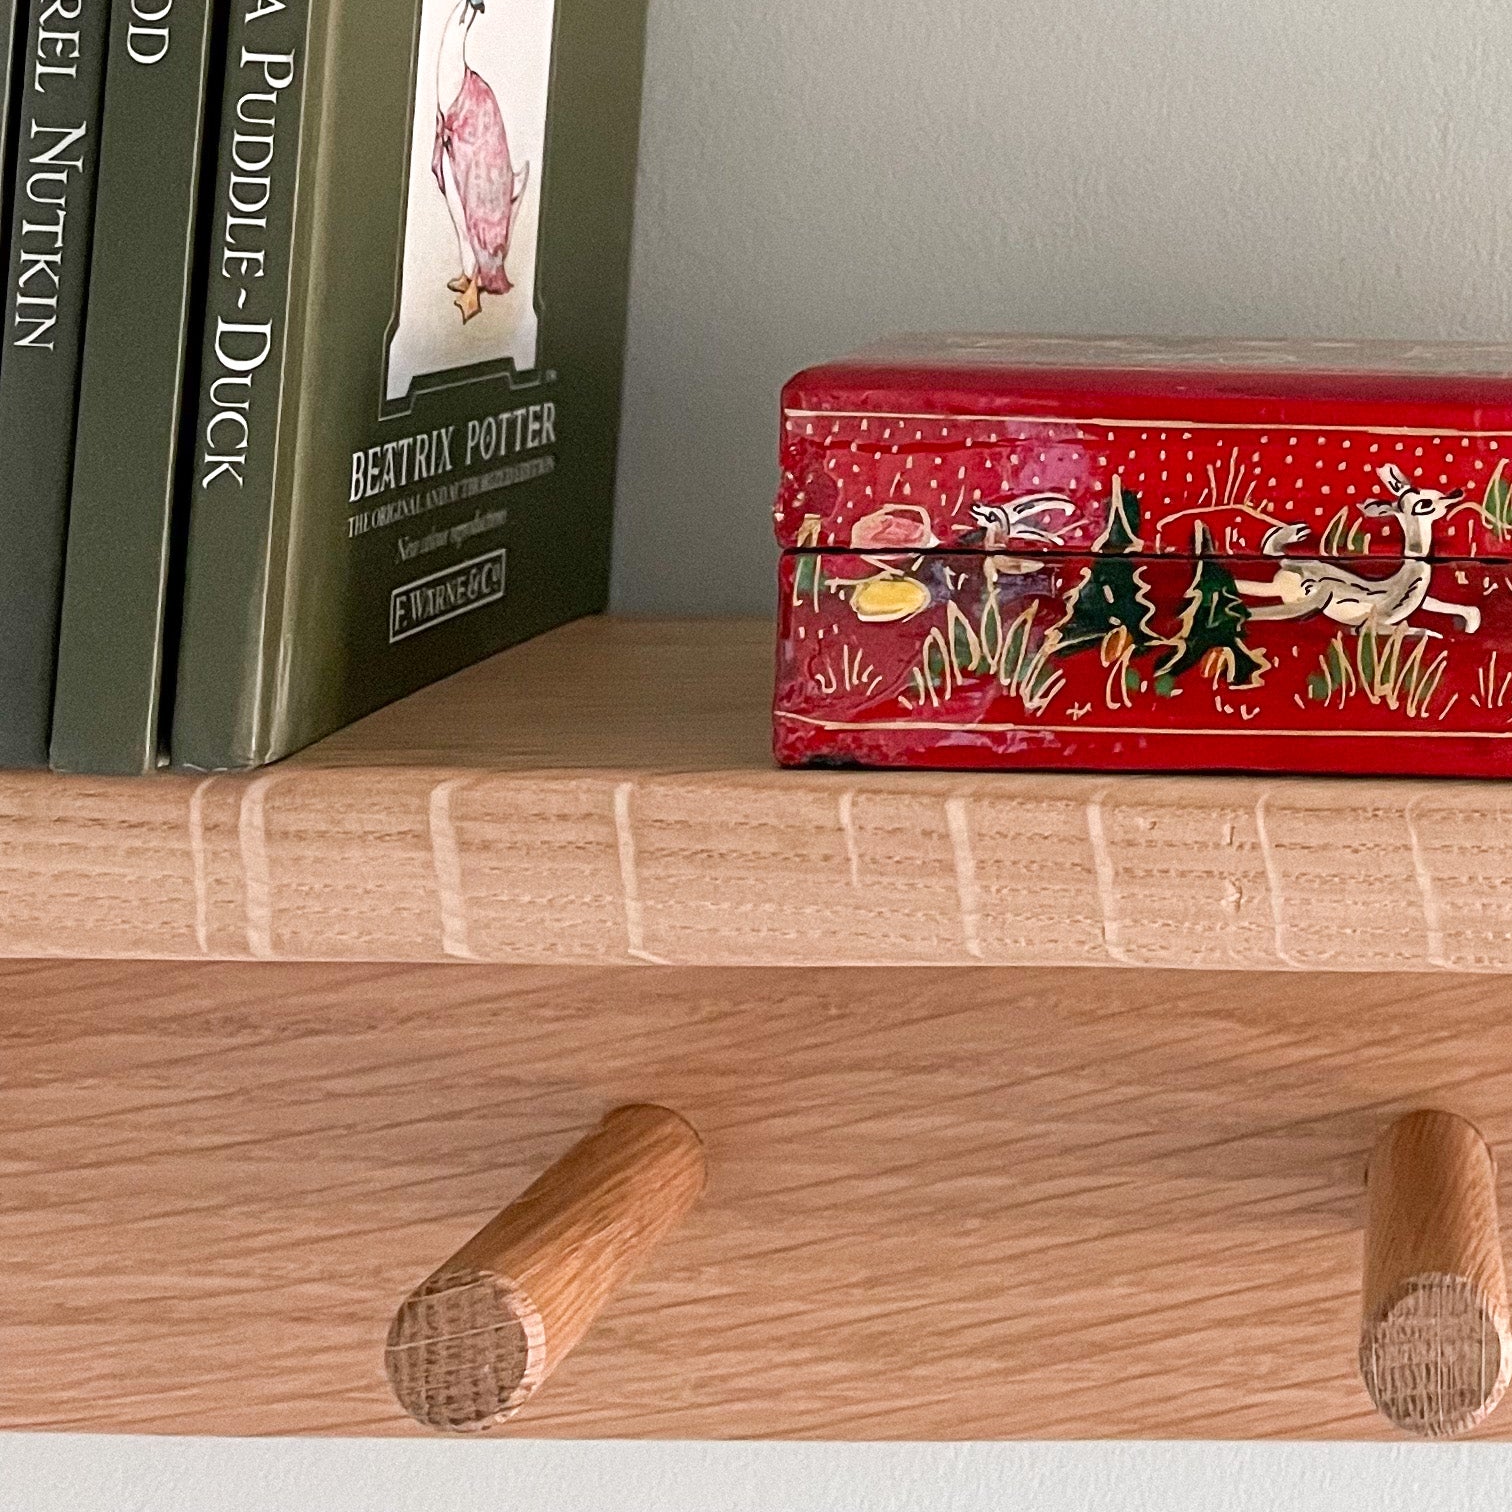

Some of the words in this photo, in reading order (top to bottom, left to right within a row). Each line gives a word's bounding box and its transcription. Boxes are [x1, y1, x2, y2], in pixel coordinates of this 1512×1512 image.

[13, 118, 88, 351] NUTKIN
[349, 425, 455, 503] BEATRIX
[465, 401, 556, 466] POTTER
